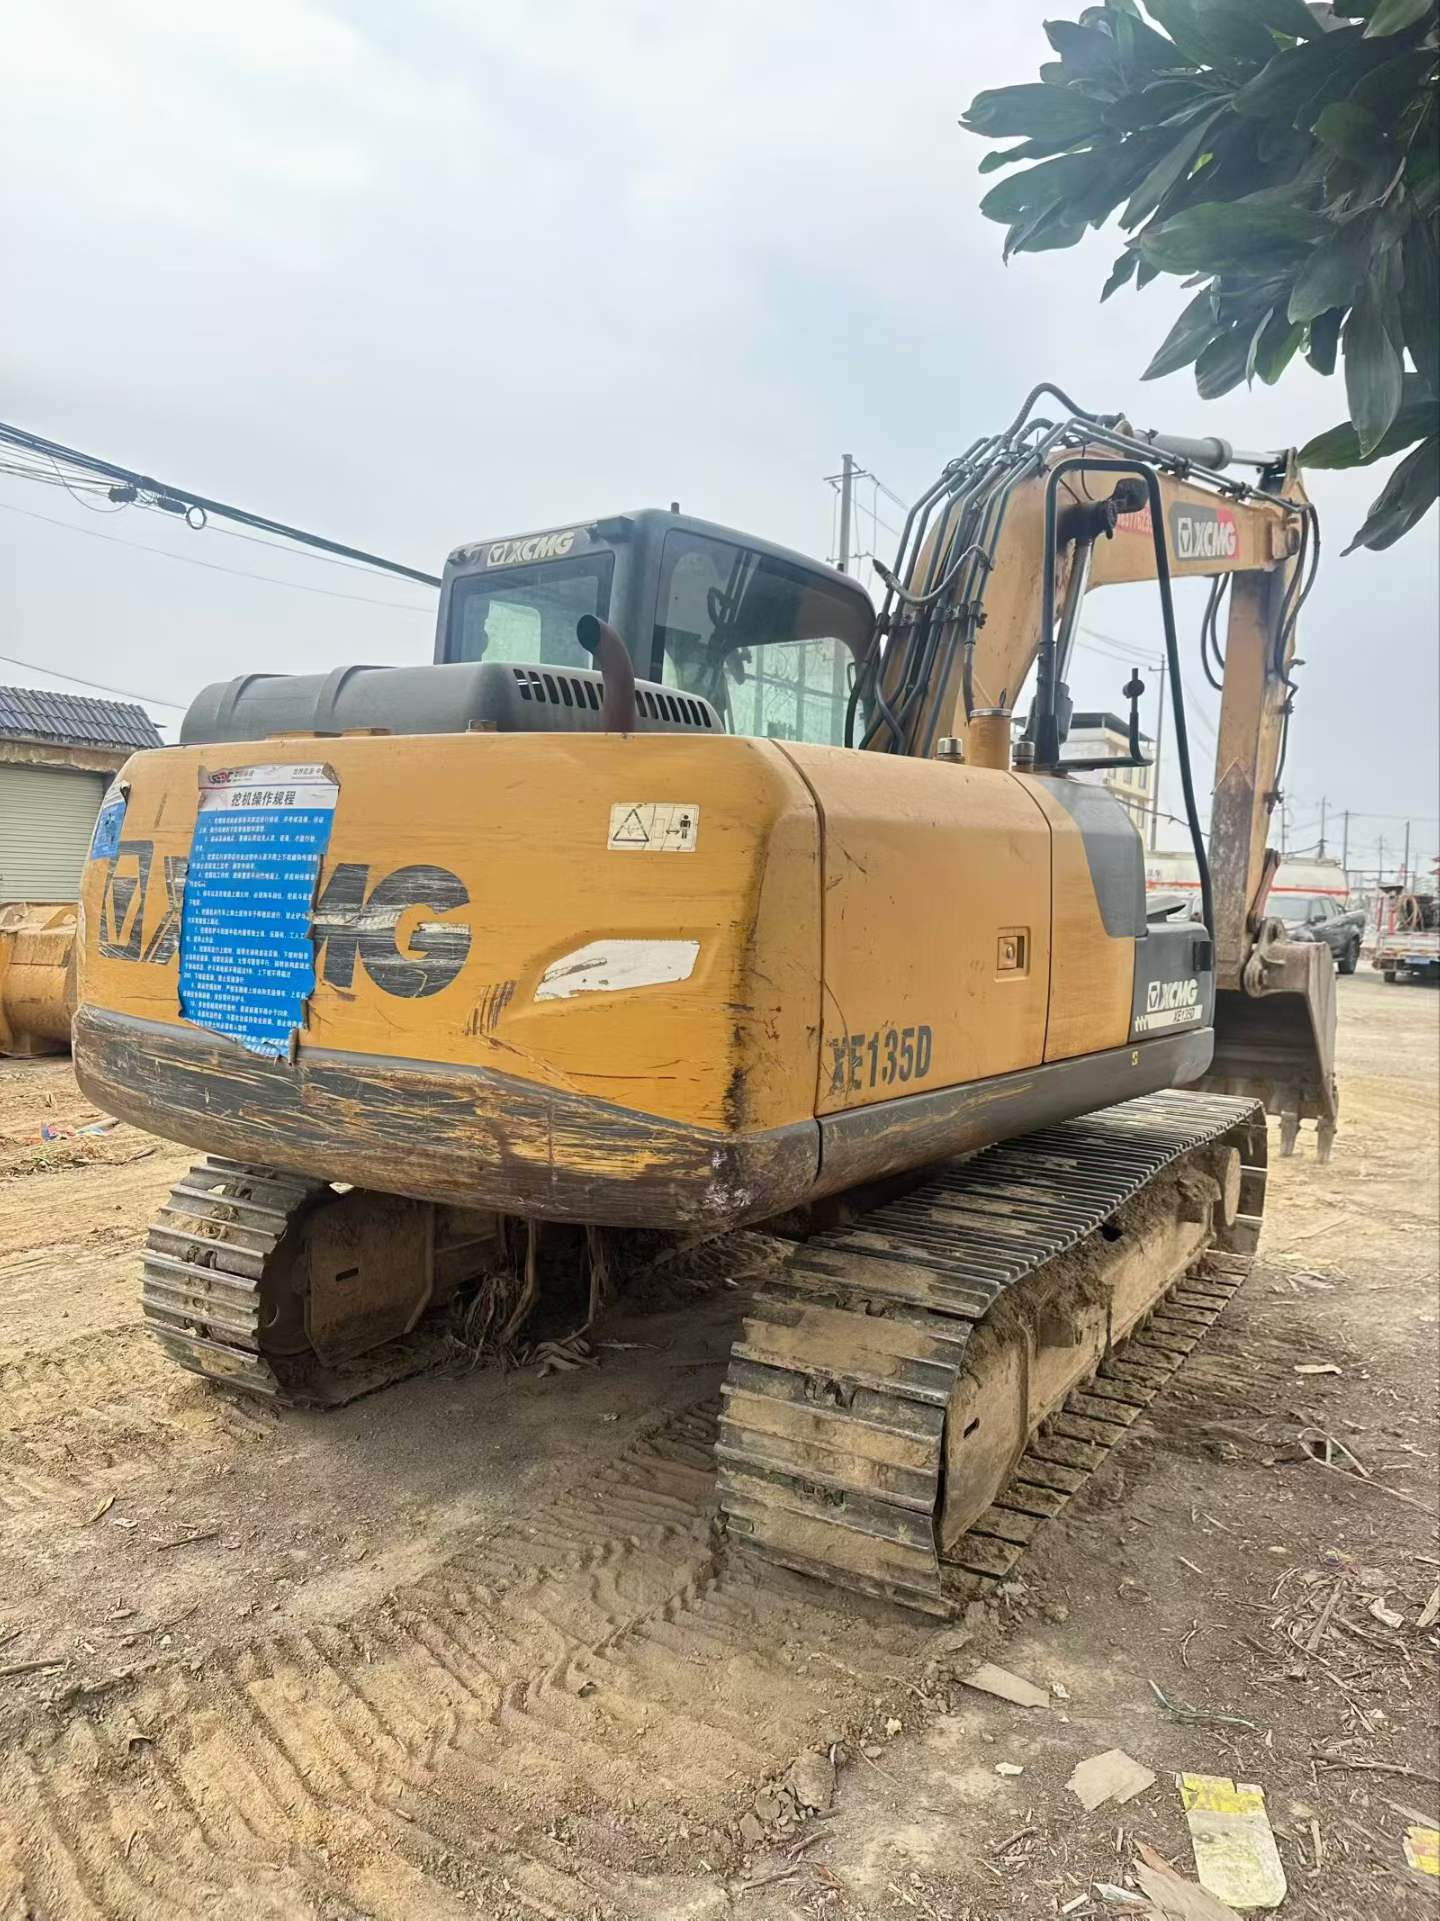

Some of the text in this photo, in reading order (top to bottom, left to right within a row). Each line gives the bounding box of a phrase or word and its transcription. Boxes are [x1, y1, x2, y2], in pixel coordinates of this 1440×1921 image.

[506, 532, 574, 562] XCMG
[1192, 521, 1236, 556] XCMG
[231, 791, 296, 806] 挖机操作规程
[1160, 979, 1198, 1009] XCMG
[831, 1025, 932, 1091] XE135D
